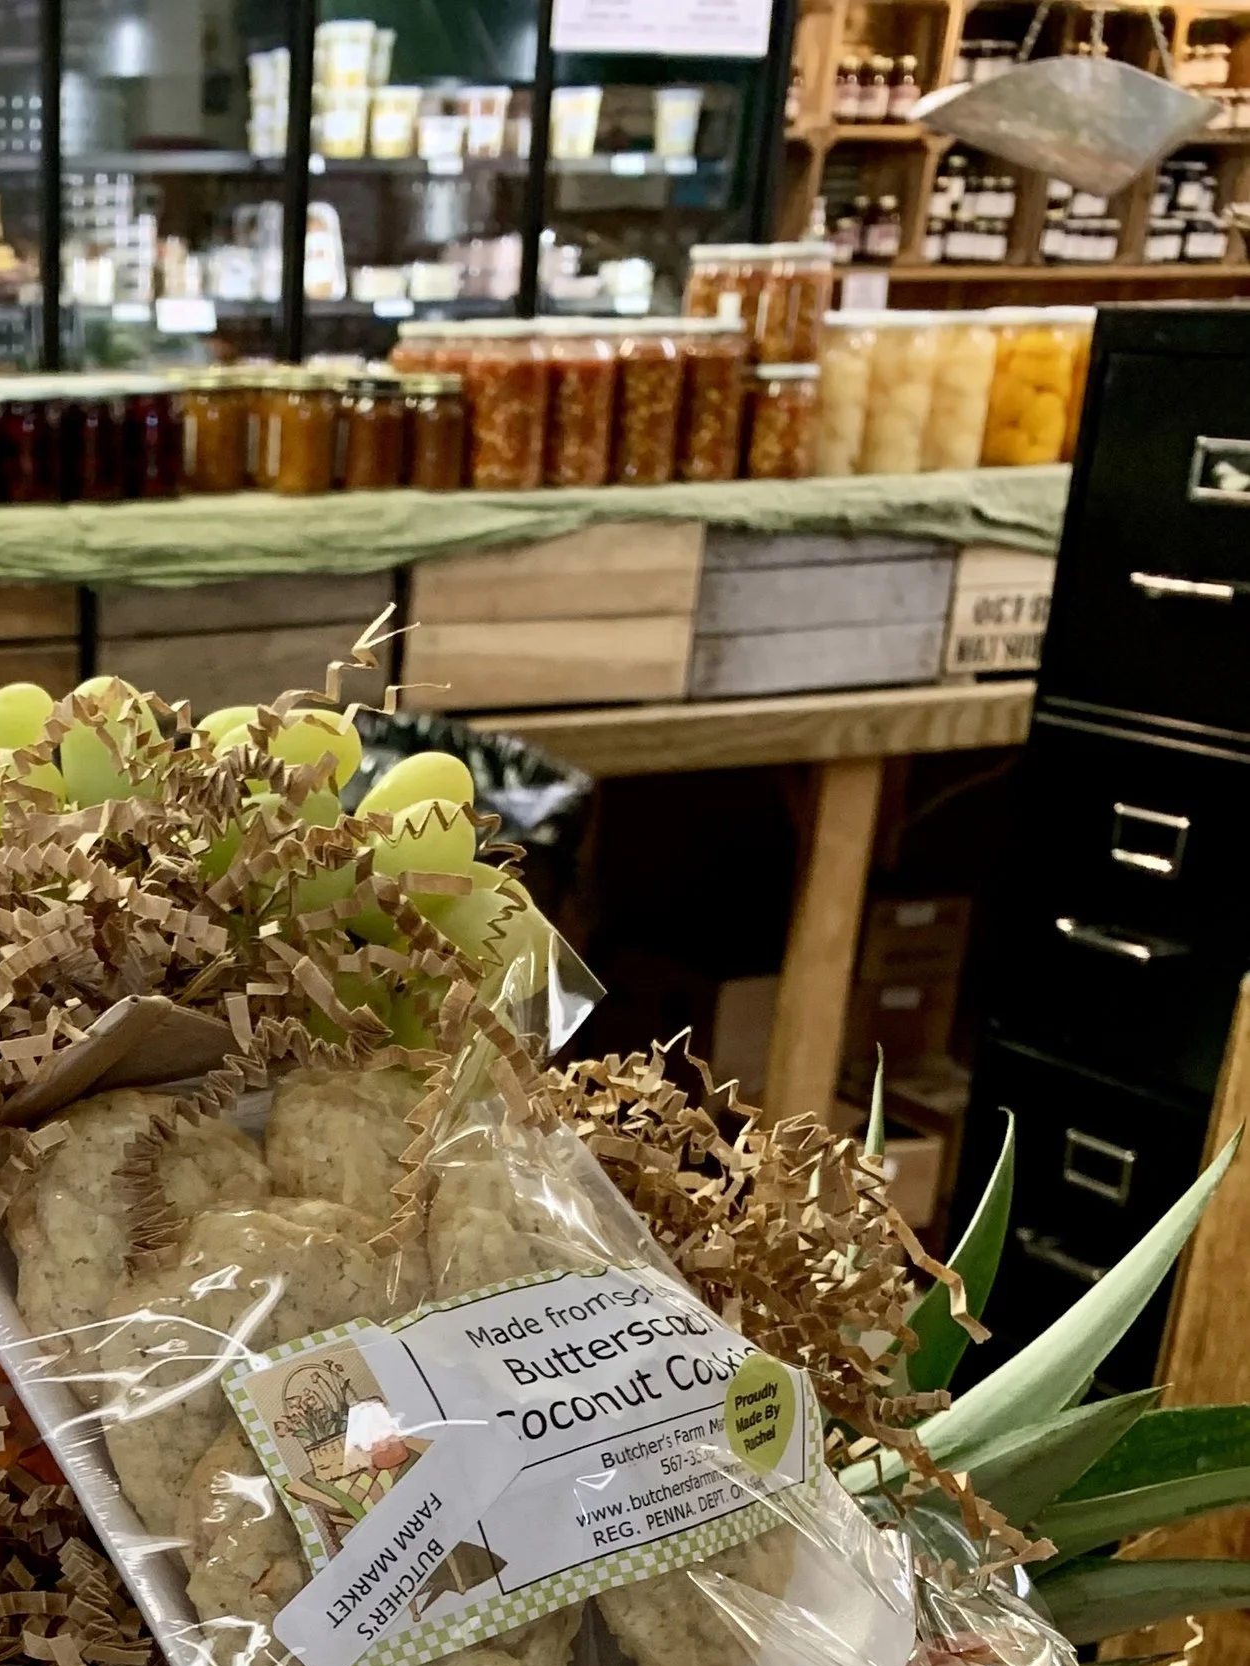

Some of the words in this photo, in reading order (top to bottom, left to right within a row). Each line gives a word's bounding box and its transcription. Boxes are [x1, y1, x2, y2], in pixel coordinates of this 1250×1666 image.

[465, 1316, 543, 1349] Made
[546, 1292, 616, 1328] from
[734, 1382, 778, 1411] Proudly
[735, 1412, 763, 1434] Made
[764, 1403, 781, 1420] By
[600, 1433, 673, 1469] Butcher's
[674, 1423, 705, 1448] Farm
[743, 1423, 776, 1455] Rachel
[393, 1492, 442, 1551] FARM
[593, 1521, 642, 1547] REG.
[646, 1503, 697, 1531] PENNA.
[326, 1547, 398, 1629] MARKET
[357, 1538, 445, 1641] BUTCHER'S
